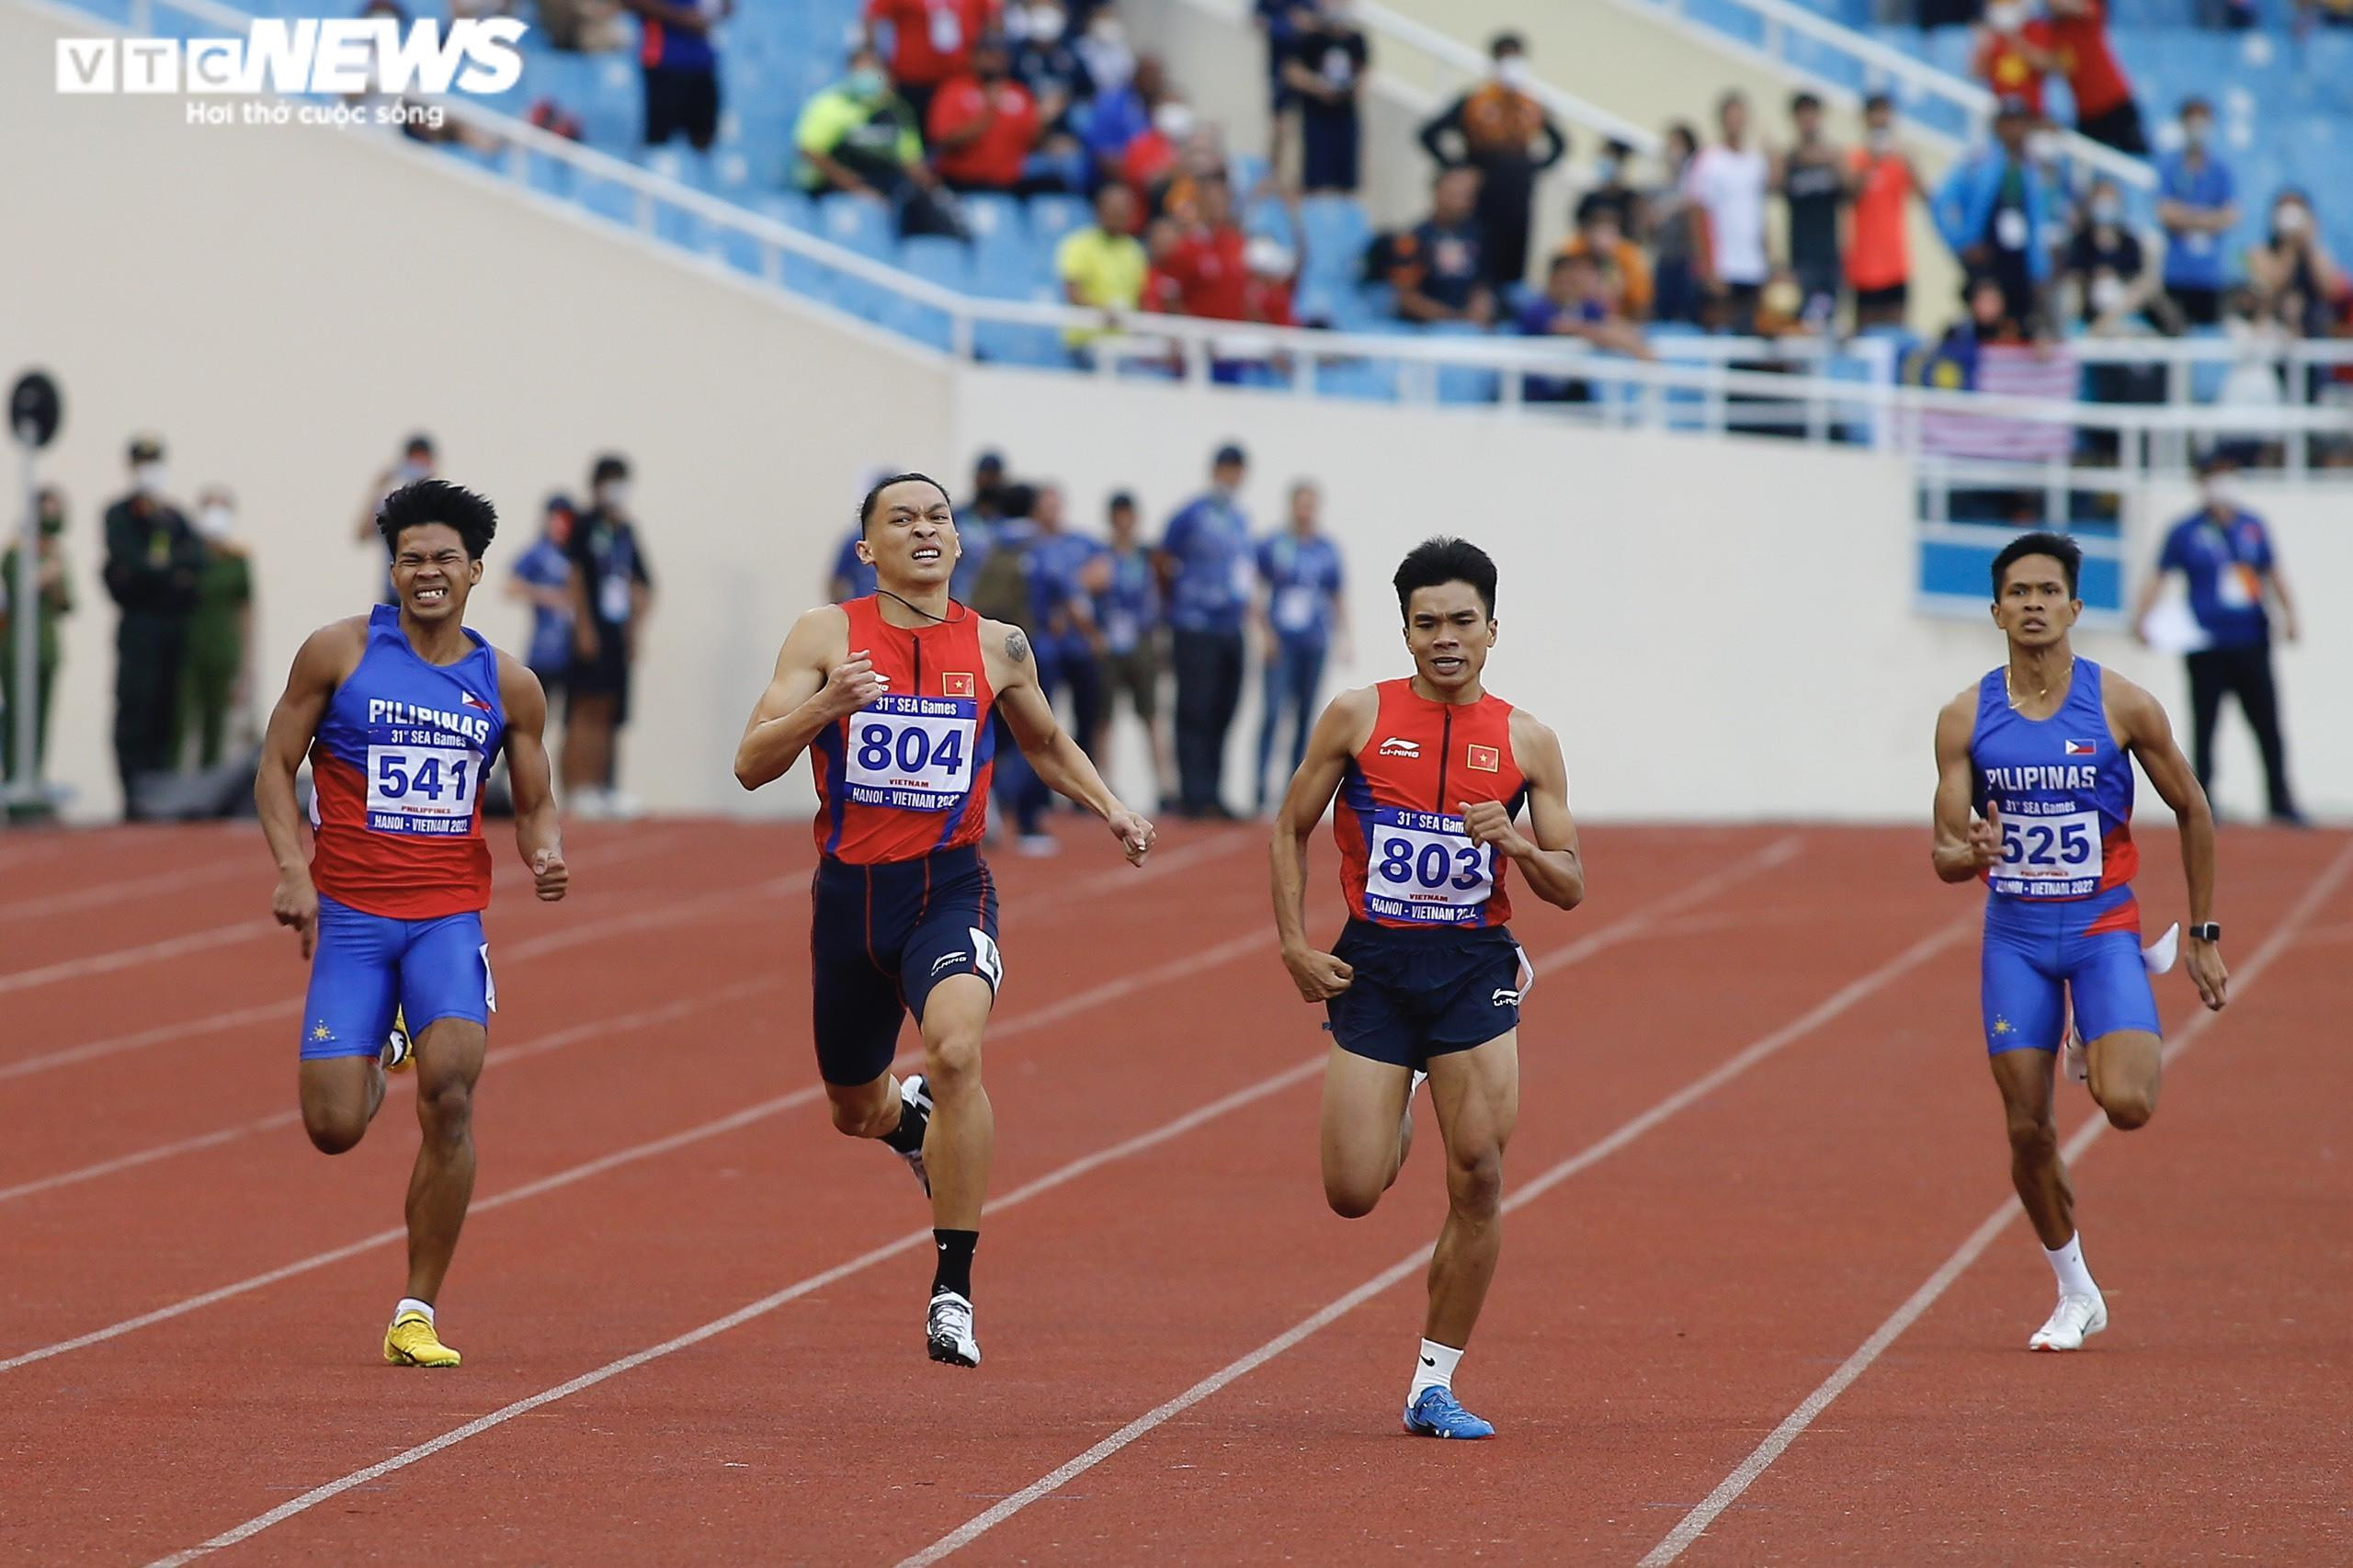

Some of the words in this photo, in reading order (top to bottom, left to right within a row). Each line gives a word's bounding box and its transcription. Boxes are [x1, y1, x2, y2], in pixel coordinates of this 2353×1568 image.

[896, 698, 919, 713] SEA
[920, 699, 957, 715] Games
[369, 699, 490, 744] PILIPINAS
[411, 731, 431, 744] SEA
[433, 732, 467, 747] Games
[857, 723, 963, 776] 804
[1379, 748, 1420, 758] LI-NING
[378, 755, 469, 801] 541
[889, 778, 929, 788] VIETNAM
[1985, 766, 2097, 791] PILIPINAS
[852, 788, 883, 804] HANOI
[892, 791, 936, 809] VIETNAM
[2022, 801, 2041, 814] SEA
[2041, 801, 2076, 814] Games
[374, 814, 404, 830] HANOI
[412, 818, 449, 832] VIETNAM
[1418, 813, 1439, 831] SEA
[1442, 817, 1465, 834] Gam
[1999, 823, 2090, 864] 525
[1379, 837, 1485, 891] 803
[1409, 893, 1449, 902] VIETNAM
[1371, 897, 1404, 916] HANOI
[1411, 905, 1455, 921] VIETNAM
